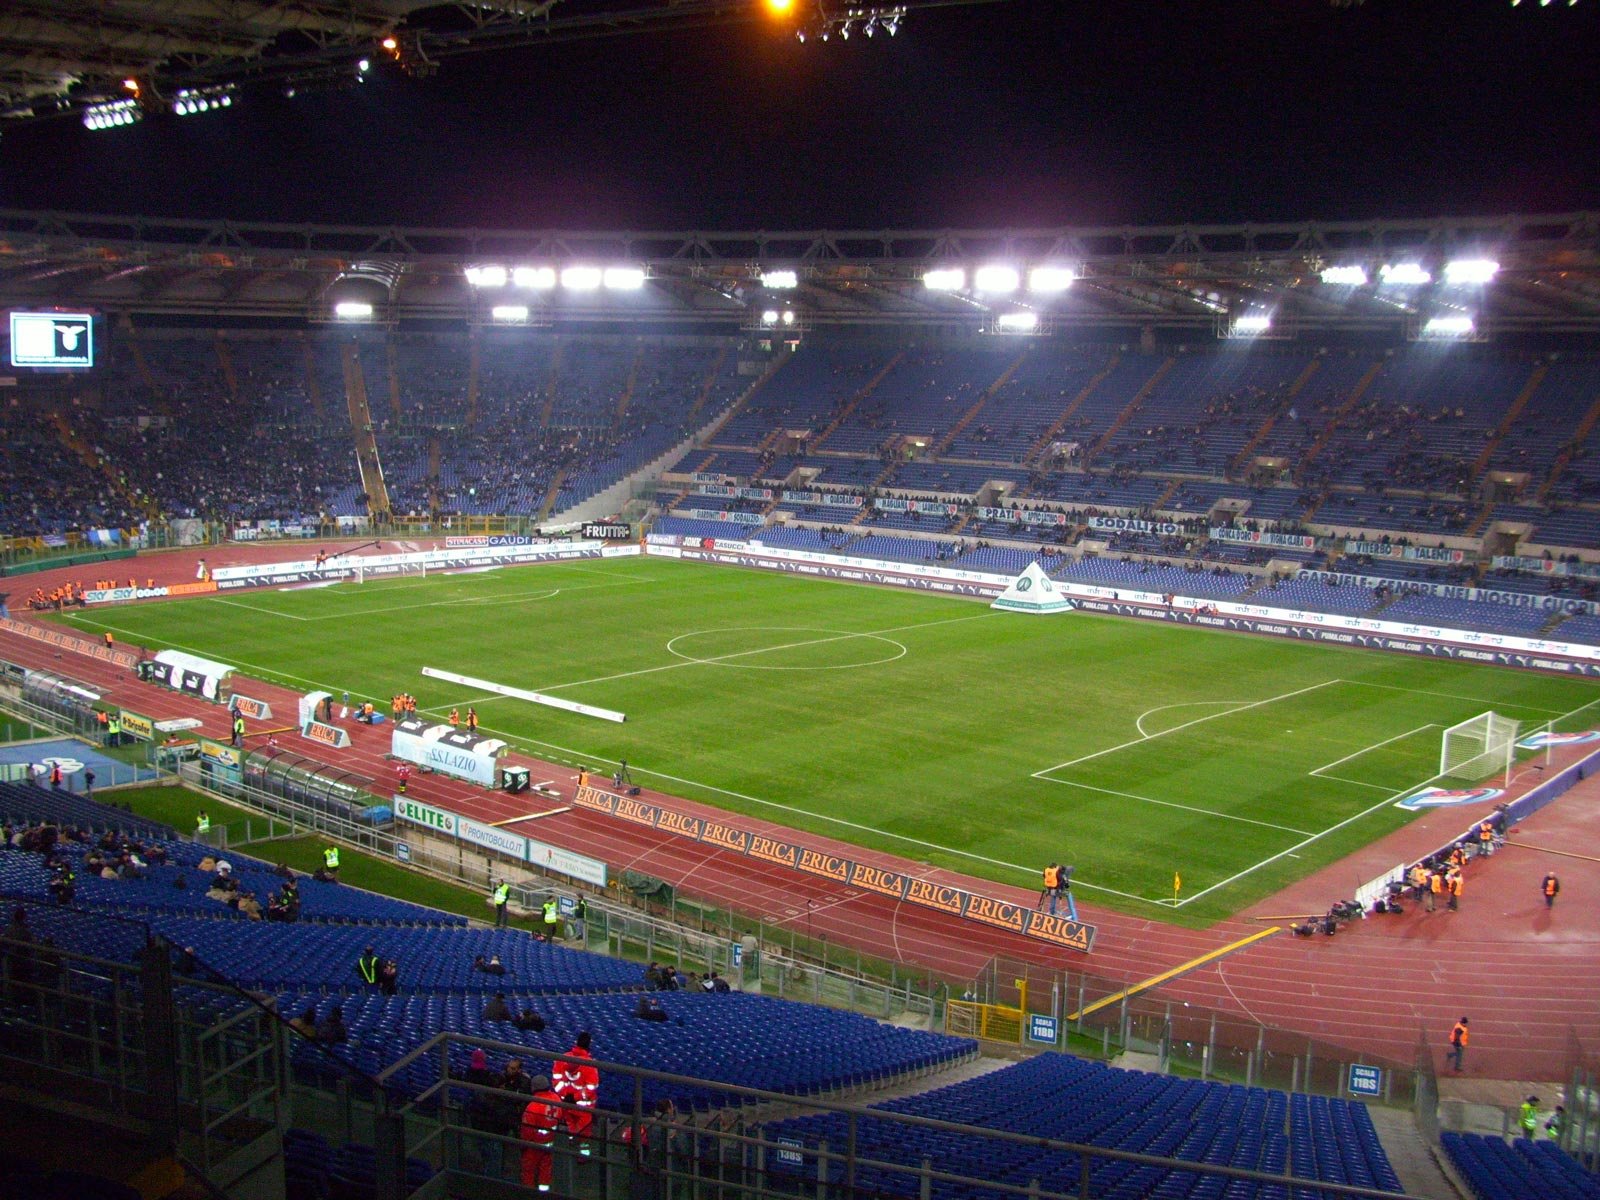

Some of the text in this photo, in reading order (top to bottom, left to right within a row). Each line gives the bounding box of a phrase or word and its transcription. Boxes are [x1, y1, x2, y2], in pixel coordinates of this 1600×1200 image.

[985, 508, 1015, 520] PRATI
[586, 525, 626, 538] FRUTTA
[1096, 517, 1177, 534] SODALIZIO
[1356, 542, 1392, 555] VITERBO
[1415, 547, 1452, 561] TALENTI
[309, 723, 336, 741] ERICA
[406, 803, 444, 828] ELITE
[467, 826, 523, 853] PRONTOBOLLO.IT
[576, 786, 612, 809] ERICA
[617, 799, 655, 821] ERICA
[659, 811, 700, 835] ERICA
[703, 824, 747, 847] ERICA
[751, 836, 796, 863] ERICA
[800, 849, 847, 877] ERICA
[854, 864, 903, 892] ERICA
[909, 880, 962, 909] ERICA
[968, 895, 1023, 929] ERICA
[1029, 911, 1088, 944] ERICA
